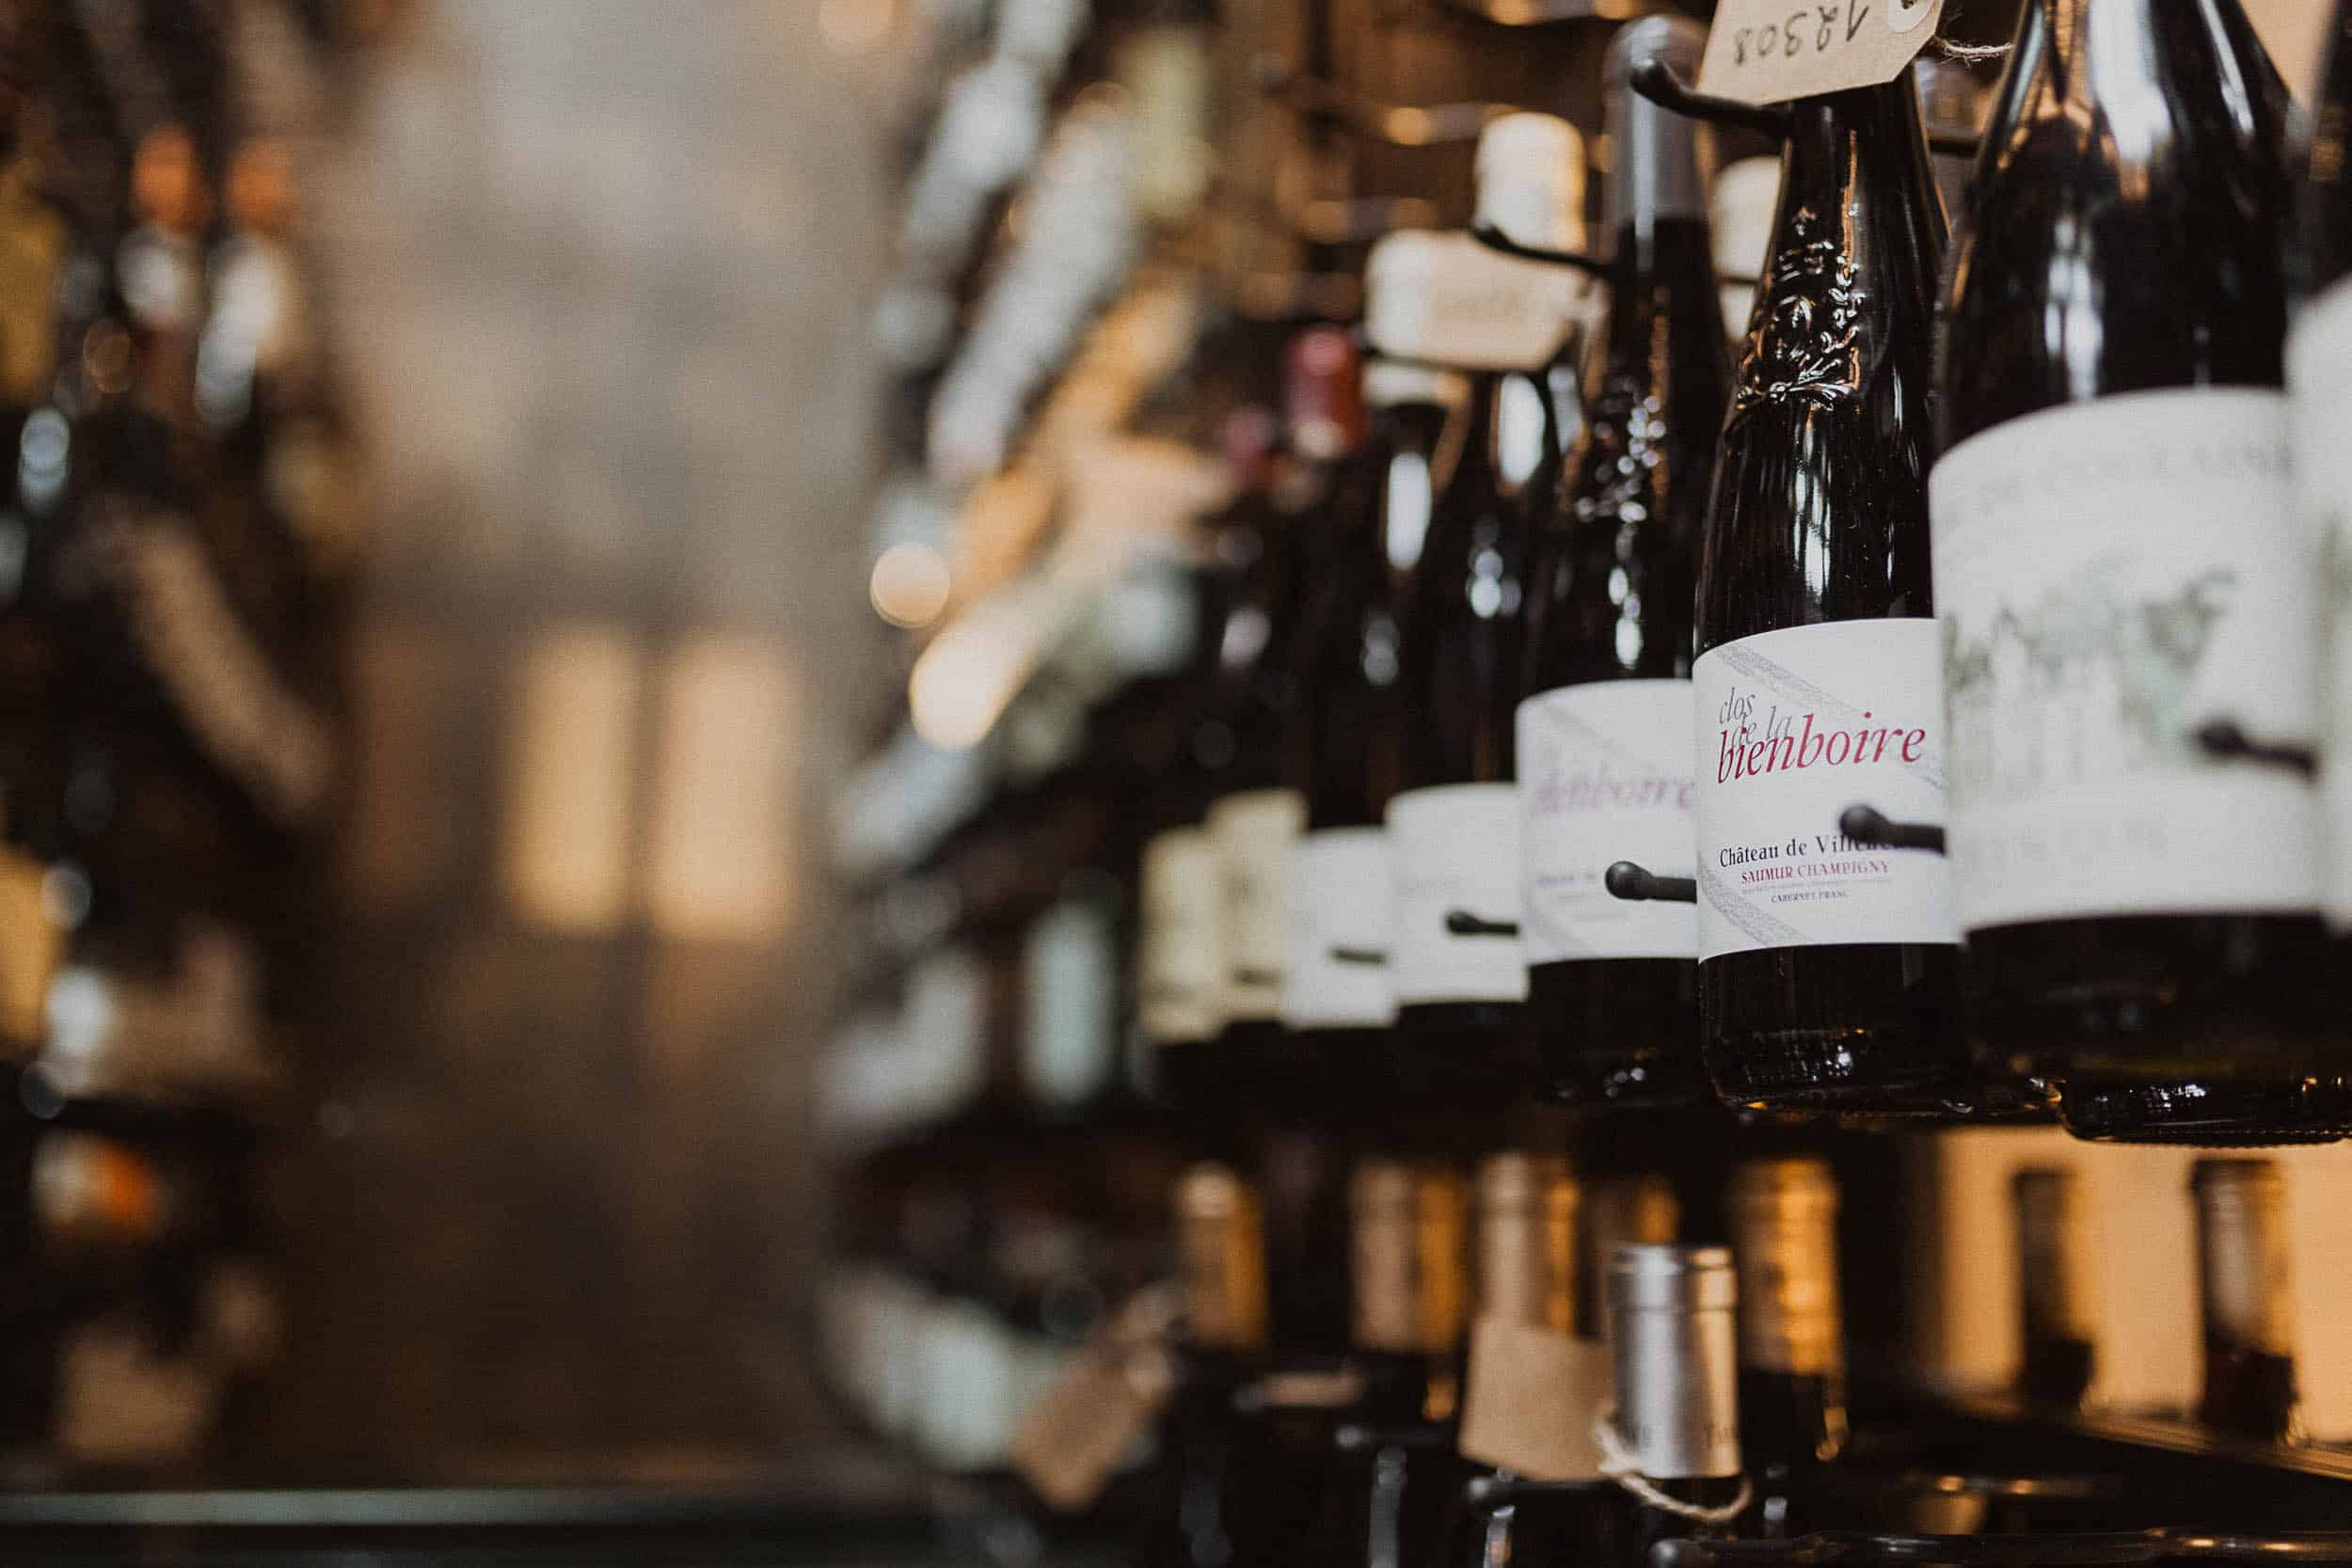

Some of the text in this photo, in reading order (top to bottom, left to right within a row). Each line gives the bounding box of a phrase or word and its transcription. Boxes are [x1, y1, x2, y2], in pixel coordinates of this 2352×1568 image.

[1719, 687, 1756, 723] clos
[1766, 705, 1792, 740] la
[1718, 711, 1927, 784] bienboire
[1720, 844, 1778, 867] Château
[1786, 838, 1807, 857] de
[1740, 860, 1891, 885] SAUMUR CHAMPIGNY
